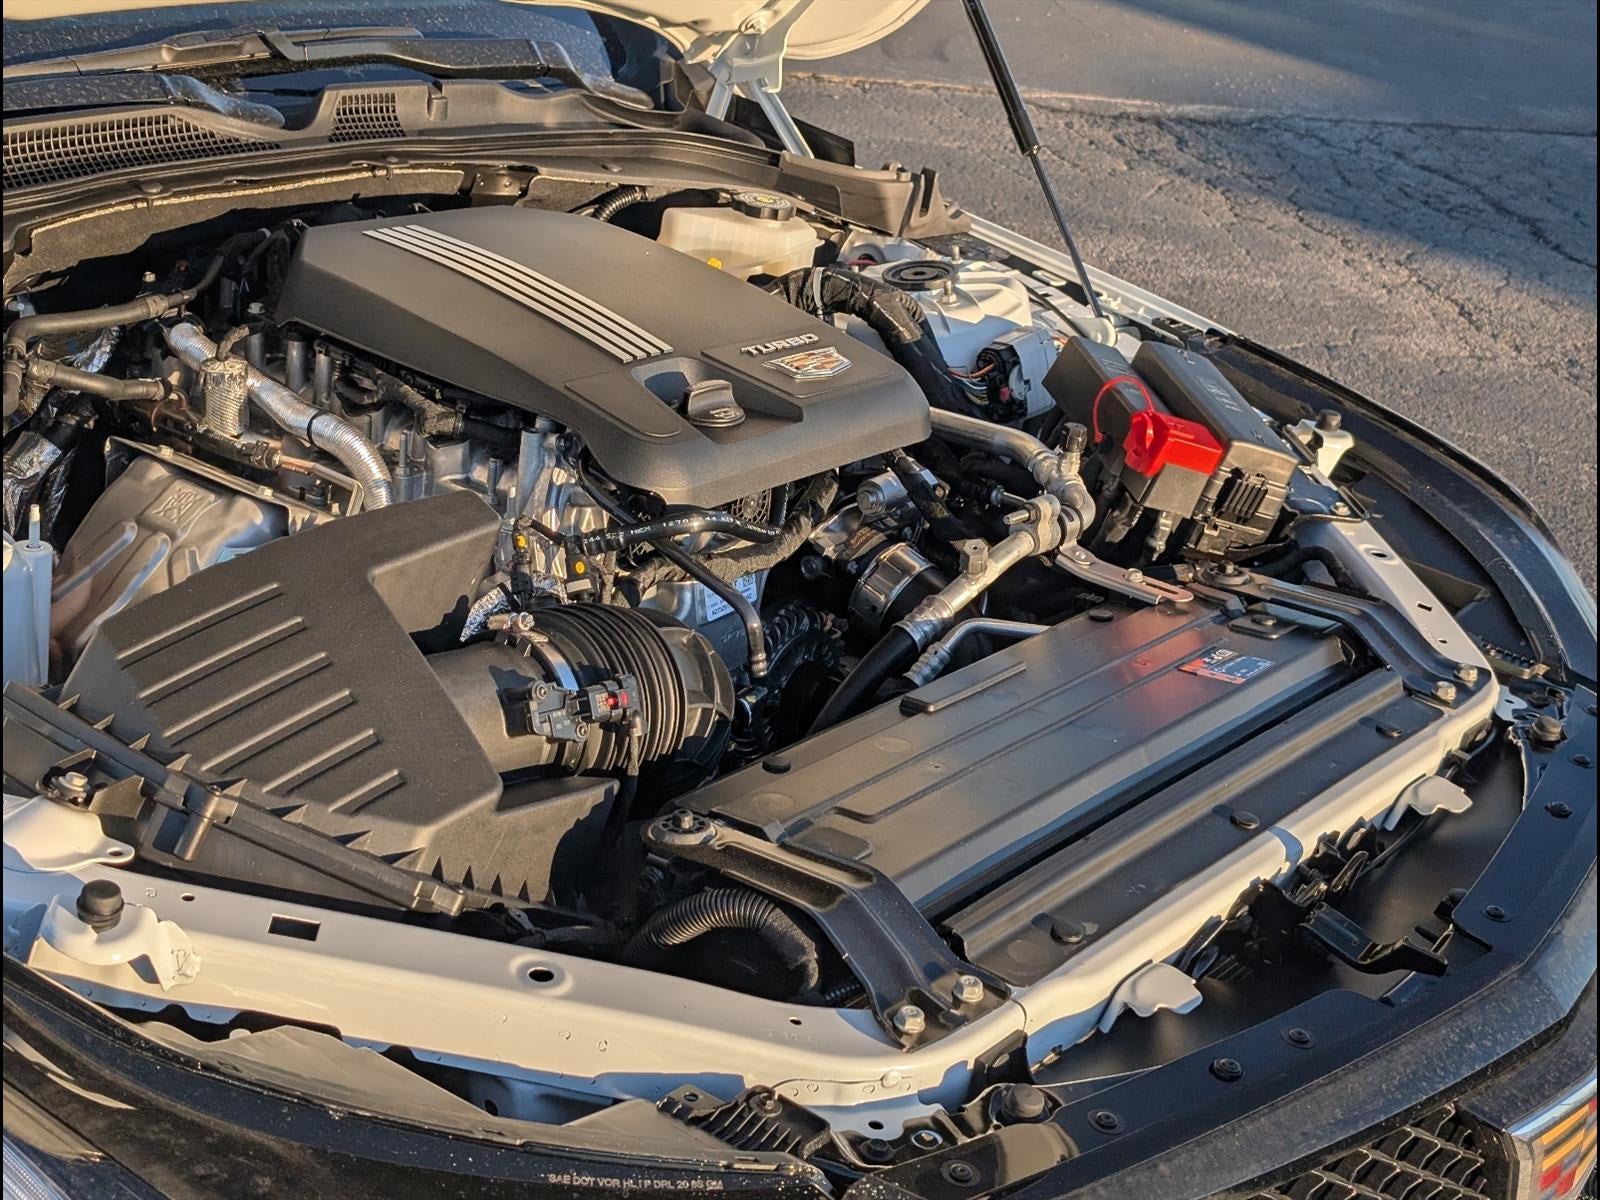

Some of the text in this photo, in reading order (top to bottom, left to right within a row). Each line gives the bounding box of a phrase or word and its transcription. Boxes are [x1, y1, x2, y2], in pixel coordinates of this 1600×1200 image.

[740, 333, 819, 356] TURBO
[548, 1174, 571, 1184] SAE
[572, 1176, 595, 1186] DOT
[597, 1178, 621, 1188] VOR
[653, 1180, 675, 1190] DRL
[676, 1180, 690, 1190] 20
